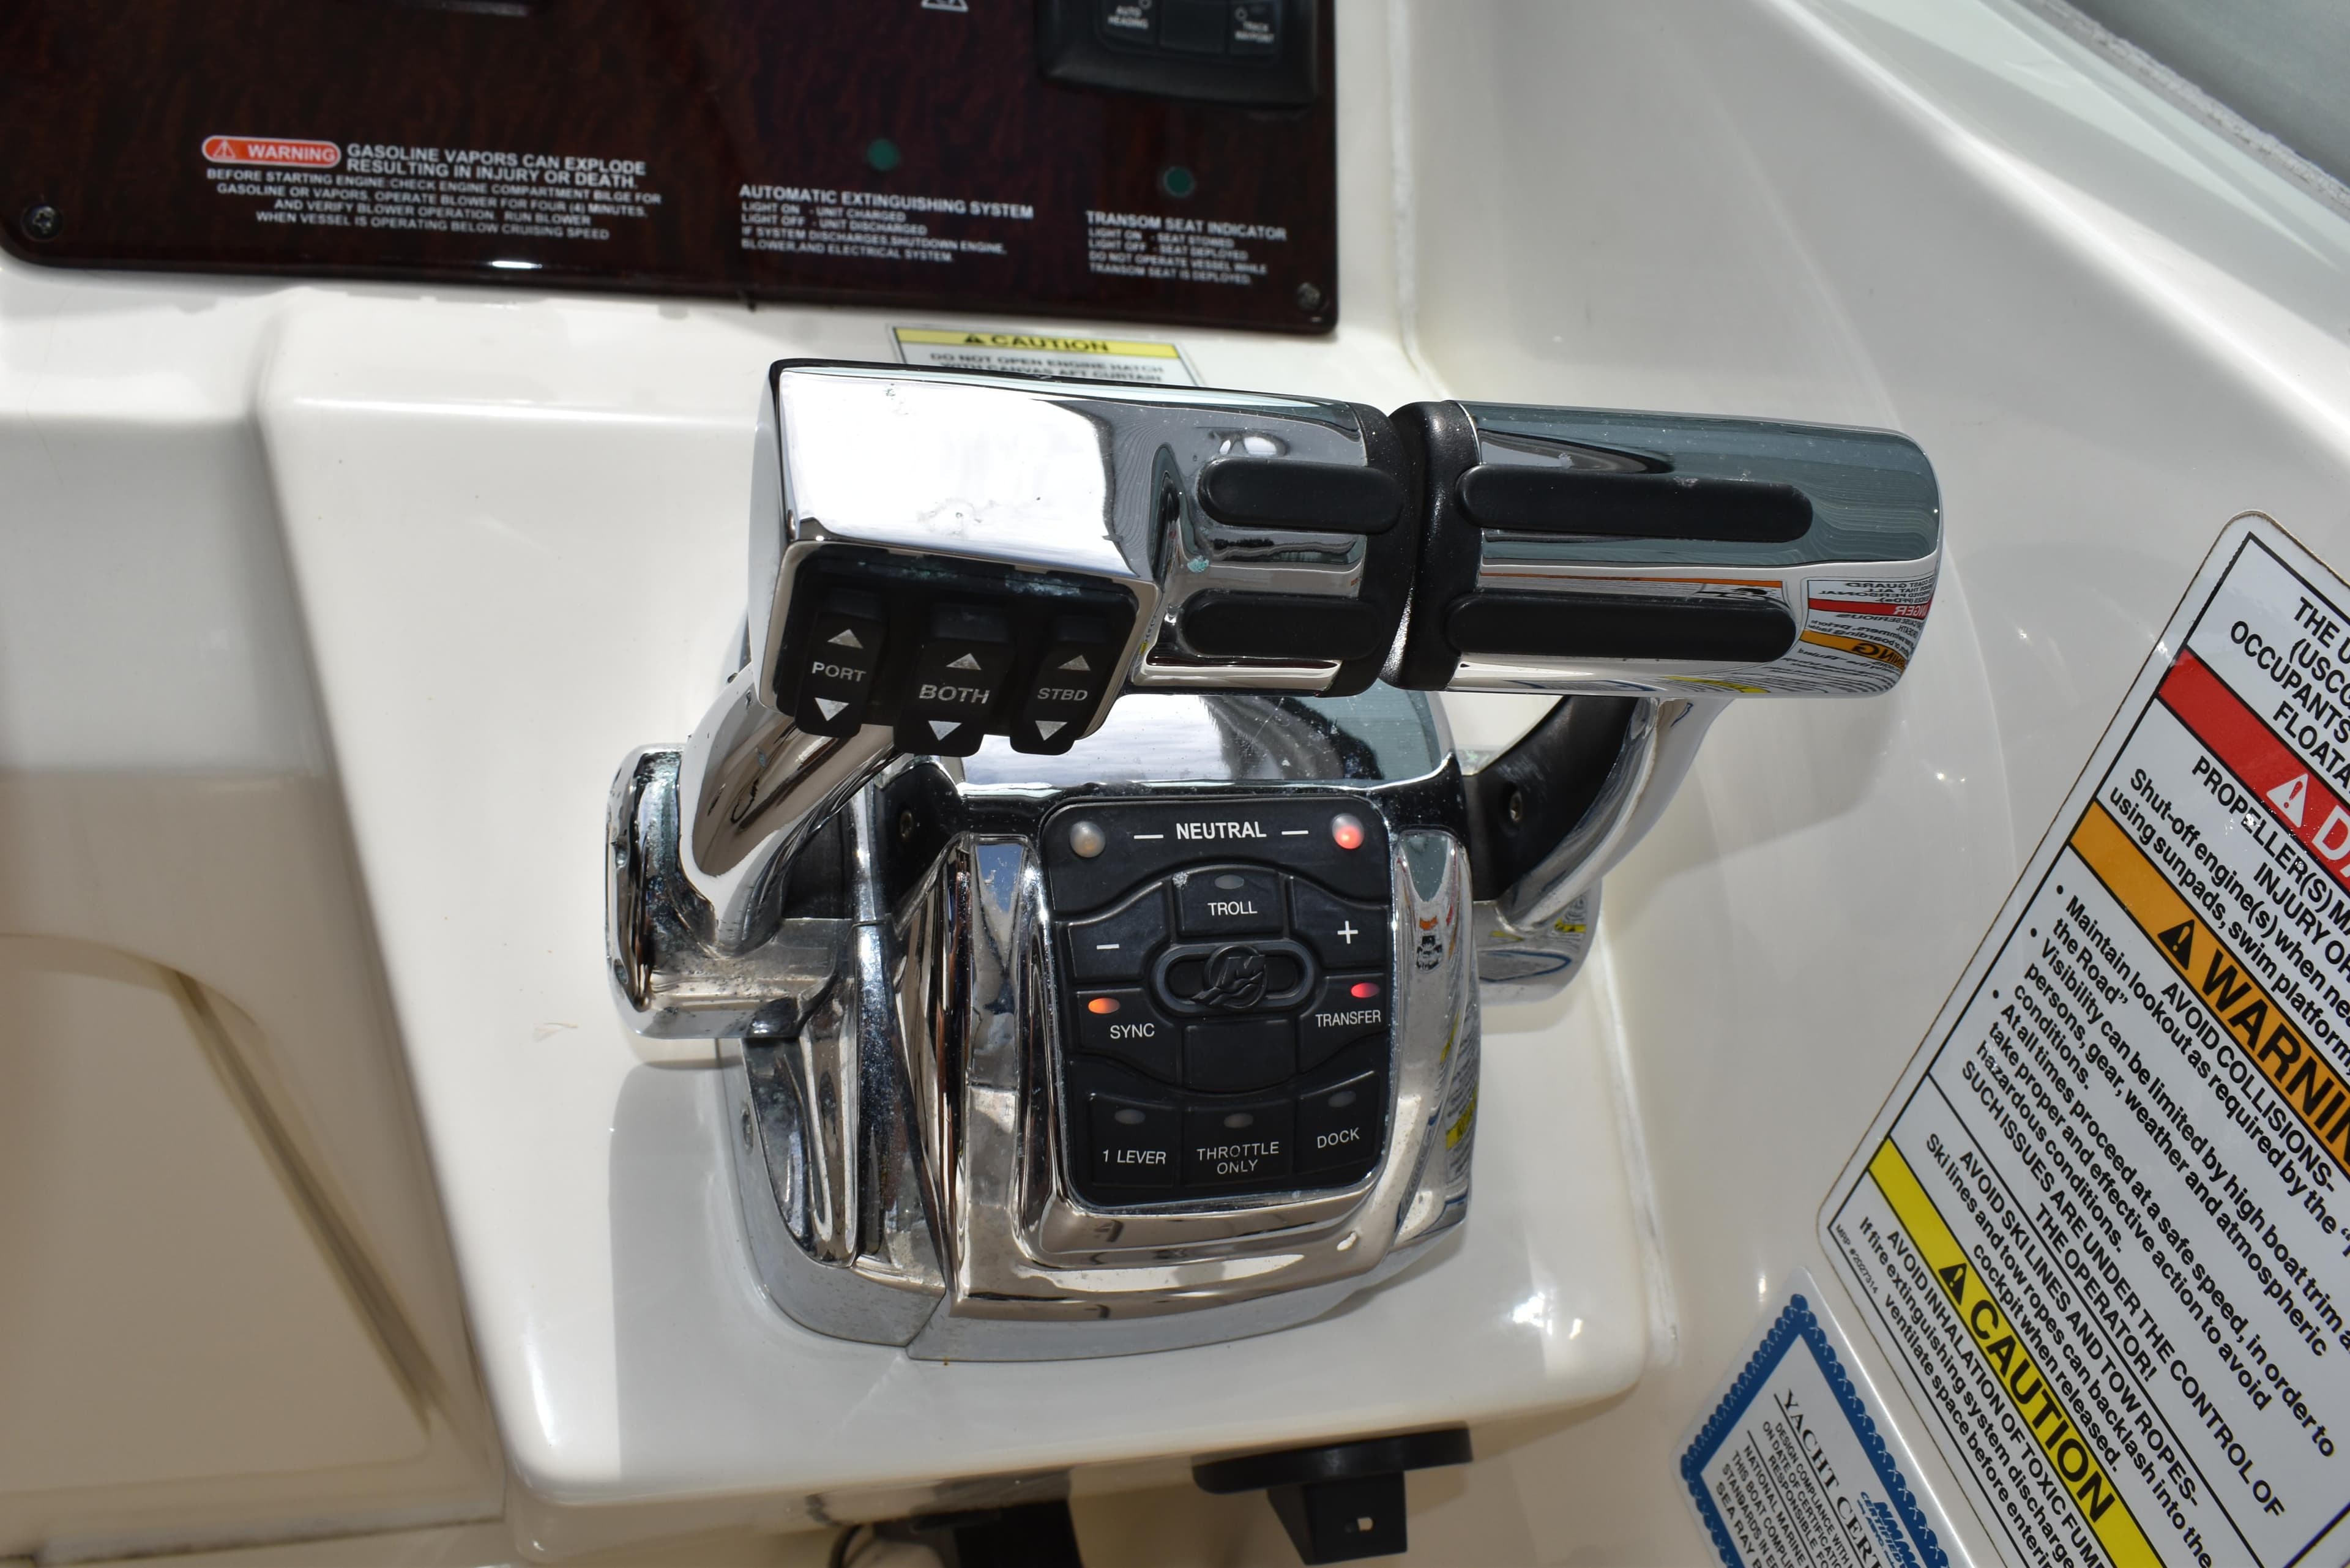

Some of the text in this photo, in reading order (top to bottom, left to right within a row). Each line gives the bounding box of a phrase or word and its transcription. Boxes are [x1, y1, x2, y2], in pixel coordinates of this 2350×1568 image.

[1108, 15, 1148, 29] HEADING
[247, 144, 335, 162] WARNING
[346, 143, 646, 175] GASOLINE VAPORS CAN EXPLODE
[346, 159, 449, 177] RESULTING
[453, 165, 471, 179] IN
[476, 166, 540, 182] INJURY
[543, 170, 570, 184] OR
[256, 210, 610, 240] WHEN VESSEL IS OPERATING BELOW CRUISING SPEED
[274, 198, 303, 210] AND
[305, 200, 354, 213] VERIFY
[357, 203, 414, 216] BLOWER
[504, 211, 532, 223] RUN
[534, 212, 591, 226] BLOWER
[738, 185, 1034, 219] AUTOMATIC EXTINGUISHING SYSTEM
[1085, 211, 1287, 241] TRANSOM SEAT INDICATOR
[991, 335, 1108, 351] CAUTION
[2294, 596, 2340, 648] THE
[812, 662, 866, 682] PORT
[919, 684, 990, 704] BOTH
[1037, 687, 1087, 701] STBD
[2231, 621, 2350, 744] OCCUPANTS
[2274, 700, 2350, 790] FLOATA
[1176, 822, 1267, 839] NEUTRAL
[2192, 756, 2333, 913] PROPELLER(S)
[1208, 902, 1258, 916] TROLL
[2110, 786, 2156, 845] using
[2154, 837, 2226, 929] sunpads,
[2228, 921, 2277, 979] swim
[2130, 769, 2326, 991] Shut-off engine(s) when
[2253, 862, 2331, 945] INJURY
[2053, 918, 2078, 955] the
[1110, 1023, 1155, 1039] SYNC
[1316, 1010, 1381, 1028] TRANSFER
[2015, 985, 2089, 1090] conditions.
[2066, 895, 2337, 1234] Maintain lookout as required by the
[2161, 983, 2334, 1192] AVOID COLLISIONS-
[1103, 1150, 1166, 1164] 1 LEVER
[1197, 1142, 1279, 1161] THROTTLE
[1217, 1160, 1258, 1174] ONLY
[1317, 1127, 1360, 1148] DOCK
[1976, 1040, 2121, 1253] hazardous conditions.
[2024, 963, 2327, 1356] persons, gear, weather and atmospheric
[2042, 938, 2343, 1333] Visibility can be limited by high boat trim
[1835, 1223, 1851, 1245] MRP
[1963, 1061, 2285, 1516] SUCH ISSUES ARE UNDER THE CONTROL OF
[2035, 1202, 2157, 1383] THE OPERATOR!
[1860, 1217, 1873, 1235] If
[1868, 1231, 1888, 1265] fire
[1887, 1264, 1966, 1395] extinguishing
[1963, 1391, 2010, 1467] system
[1927, 1133, 2212, 1568] Ski lines and tow ropes can backlash into the
[1960, 1151, 2198, 1506] AVOID SKI LINES AND TOW ROPES-
[1974, 1244, 2121, 1473] cockpit when released.
[1886, 1294, 2009, 1503] ventilate space before
[1887, 1231, 2066, 1515] AVOID INHALATION OF TOXIC
[1785, 1389, 1840, 1490] YACHT
[1971, 1299, 2116, 1523] CAUTION
[1732, 1450, 1767, 1516] THIS BOAT
[1762, 1421, 1800, 1488] ON DATE OF
[1715, 1484, 1754, 1555] SEA RAY
[1744, 1445, 1805, 1566] NATIONAL MARINE
[1769, 1455, 1818, 1550] RESPONSIBLE
[1775, 1422, 1850, 1565] DESIGN COMPLIANCE WITH
[1758, 1539, 1770, 1556] IN
